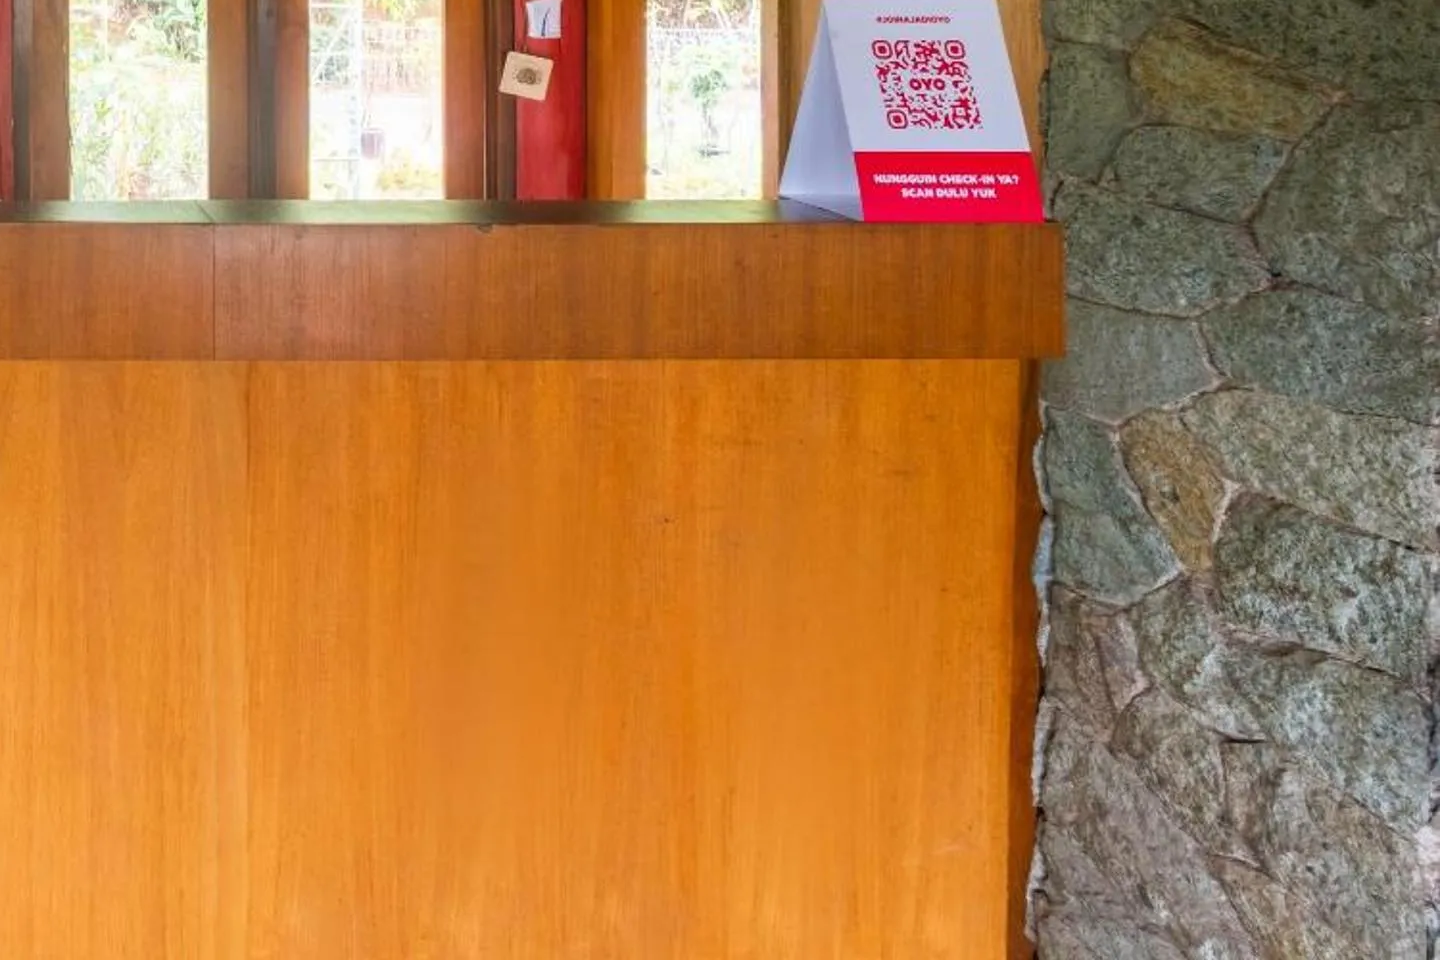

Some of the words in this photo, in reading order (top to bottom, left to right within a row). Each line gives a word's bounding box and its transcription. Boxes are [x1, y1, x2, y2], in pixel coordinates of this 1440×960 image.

[909, 78, 945, 91] OYO
[939, 173, 995, 185] CHECK-IN
[996, 173, 1019, 185] YA?
[901, 187, 934, 198] SCAN
[936, 187, 968, 198] DULU
[971, 187, 997, 198] YUK
